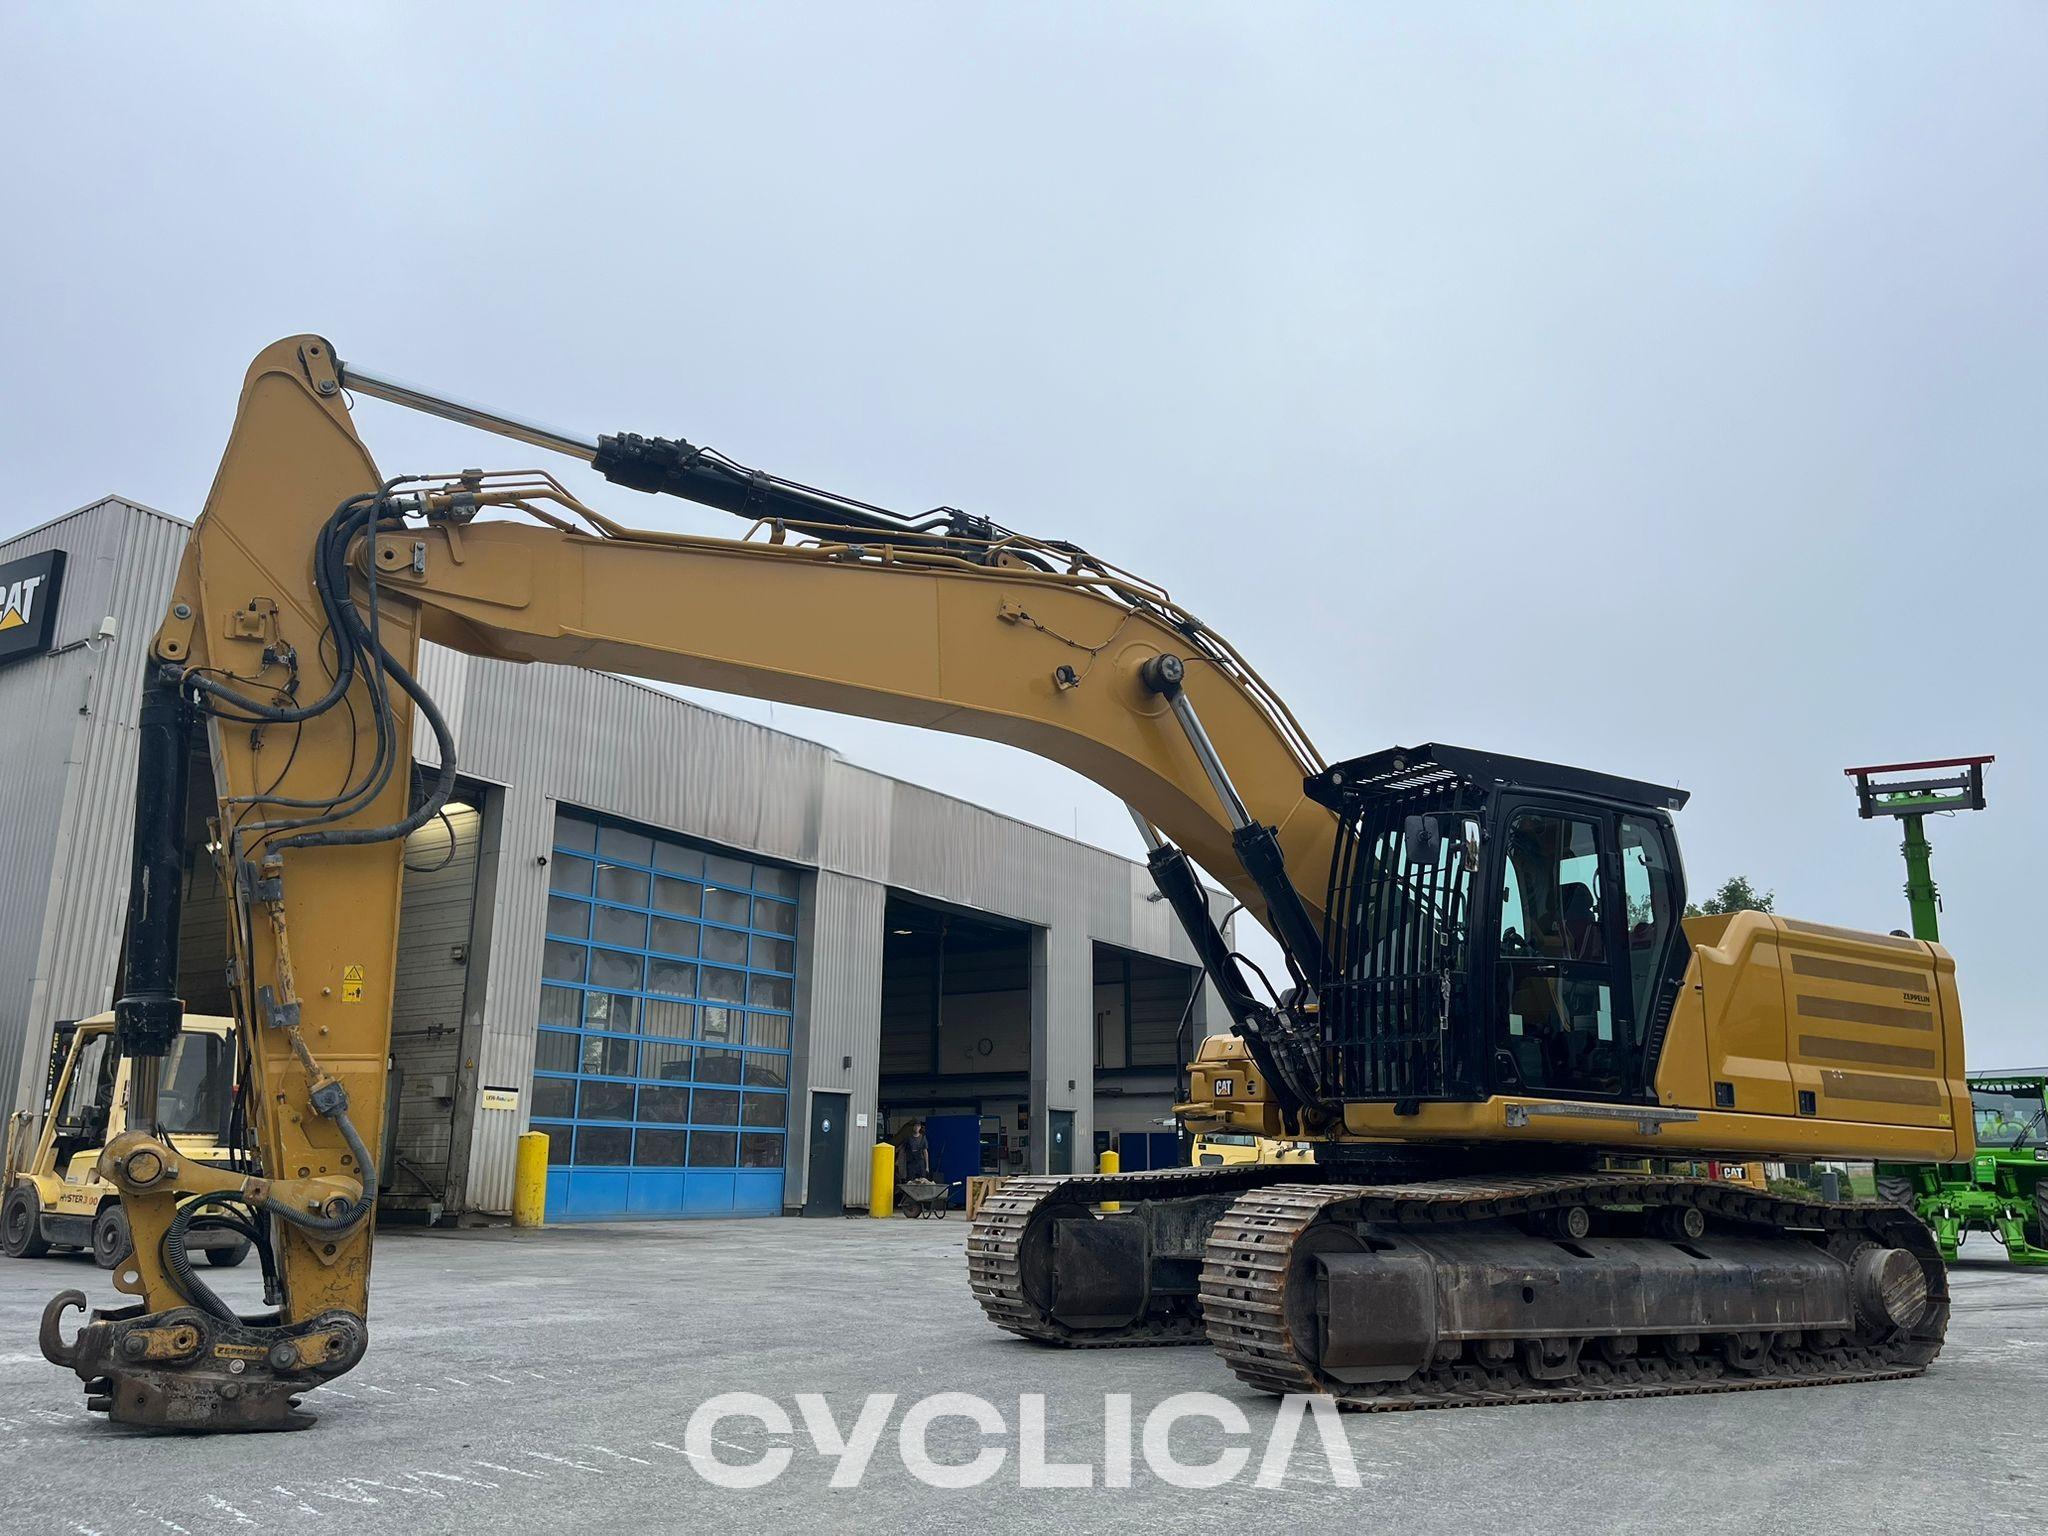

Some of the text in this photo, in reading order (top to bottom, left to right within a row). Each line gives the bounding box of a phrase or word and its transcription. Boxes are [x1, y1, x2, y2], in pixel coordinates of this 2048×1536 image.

[1903, 992, 1930, 1003] ZEPPELIN
[1216, 1080, 1232, 1095] CAT
[1723, 1167, 1743, 1179] CAT
[60, 1194, 83, 1203] HYSTER
